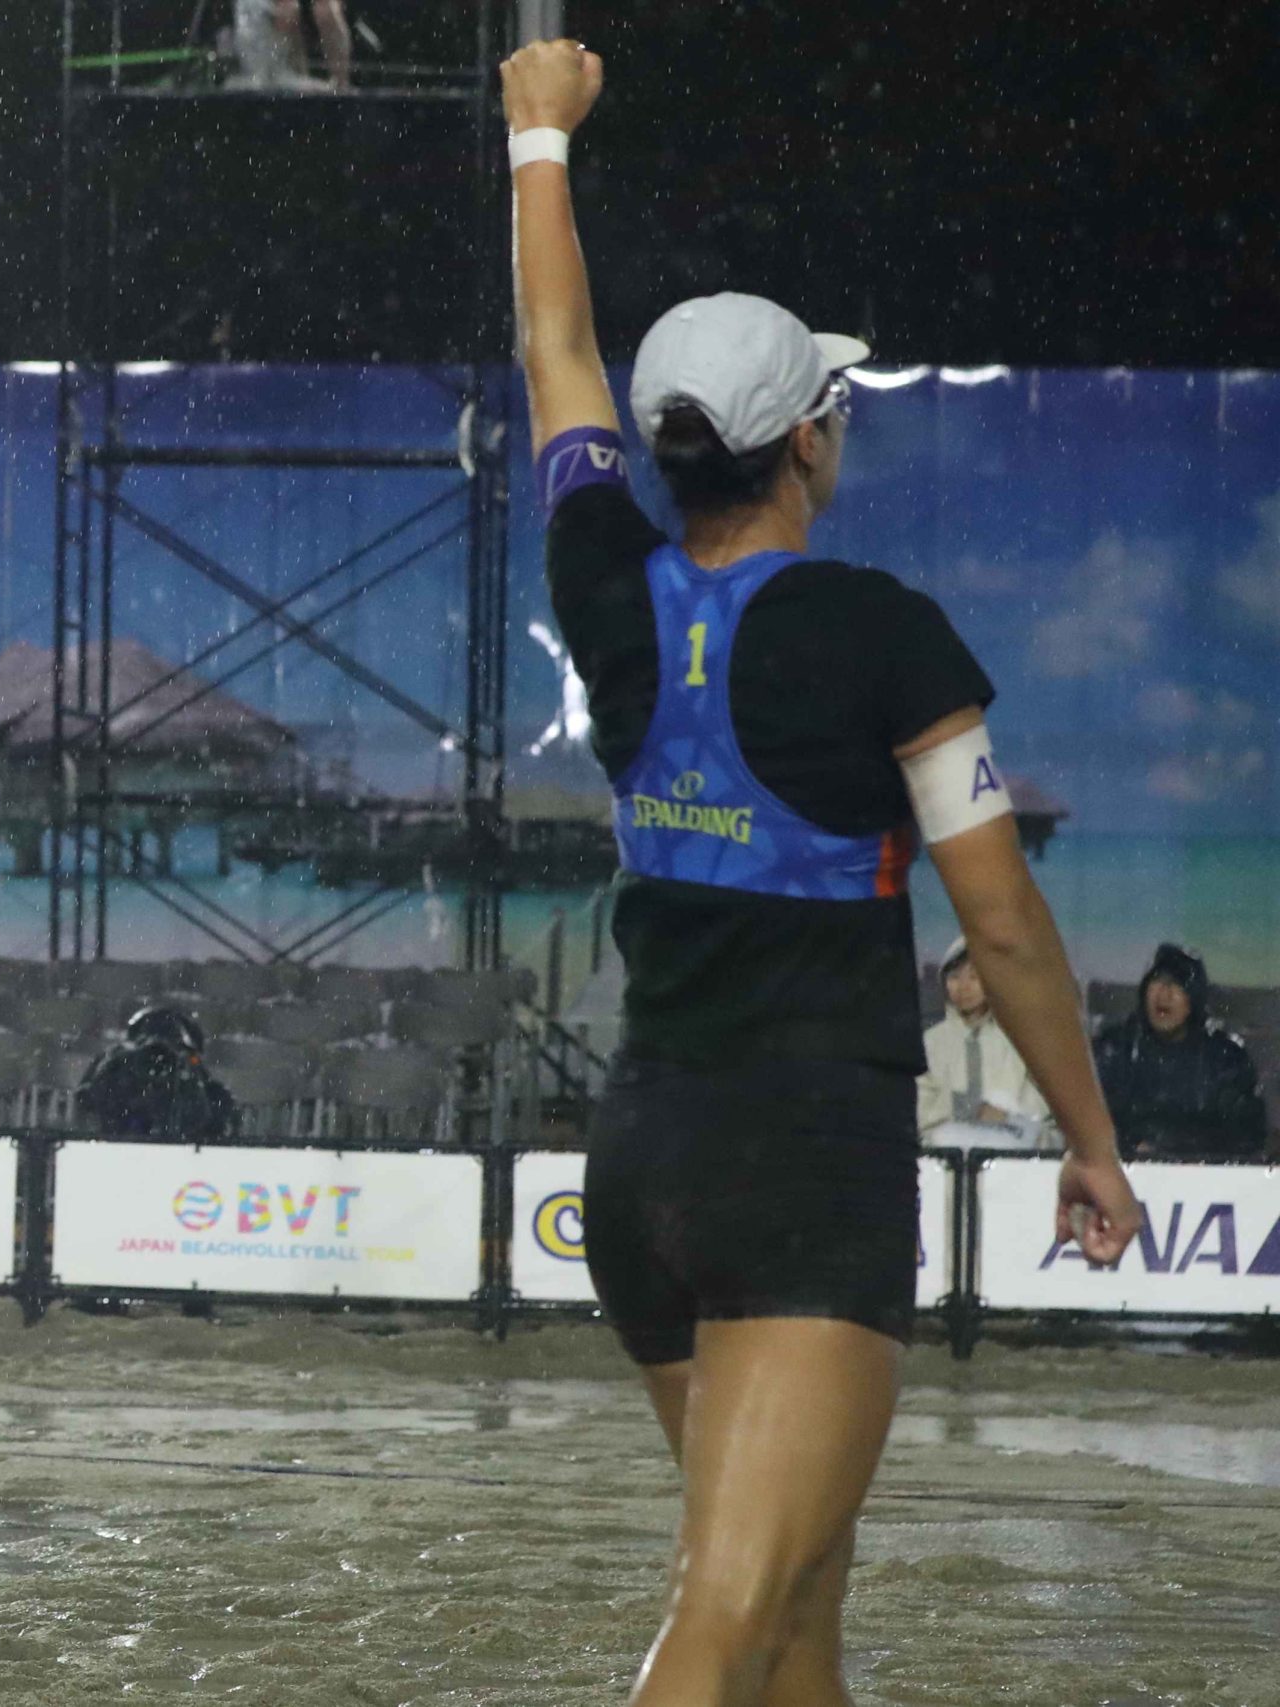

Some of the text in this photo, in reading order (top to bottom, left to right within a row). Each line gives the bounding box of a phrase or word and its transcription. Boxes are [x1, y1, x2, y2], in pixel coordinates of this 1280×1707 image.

[686, 622, 707, 687] 1
[238, 1182, 361, 1238] BVT
[118, 1238, 175, 1253] JAPAN
[181, 1240, 359, 1262] BEACHVOLLEYBALL
